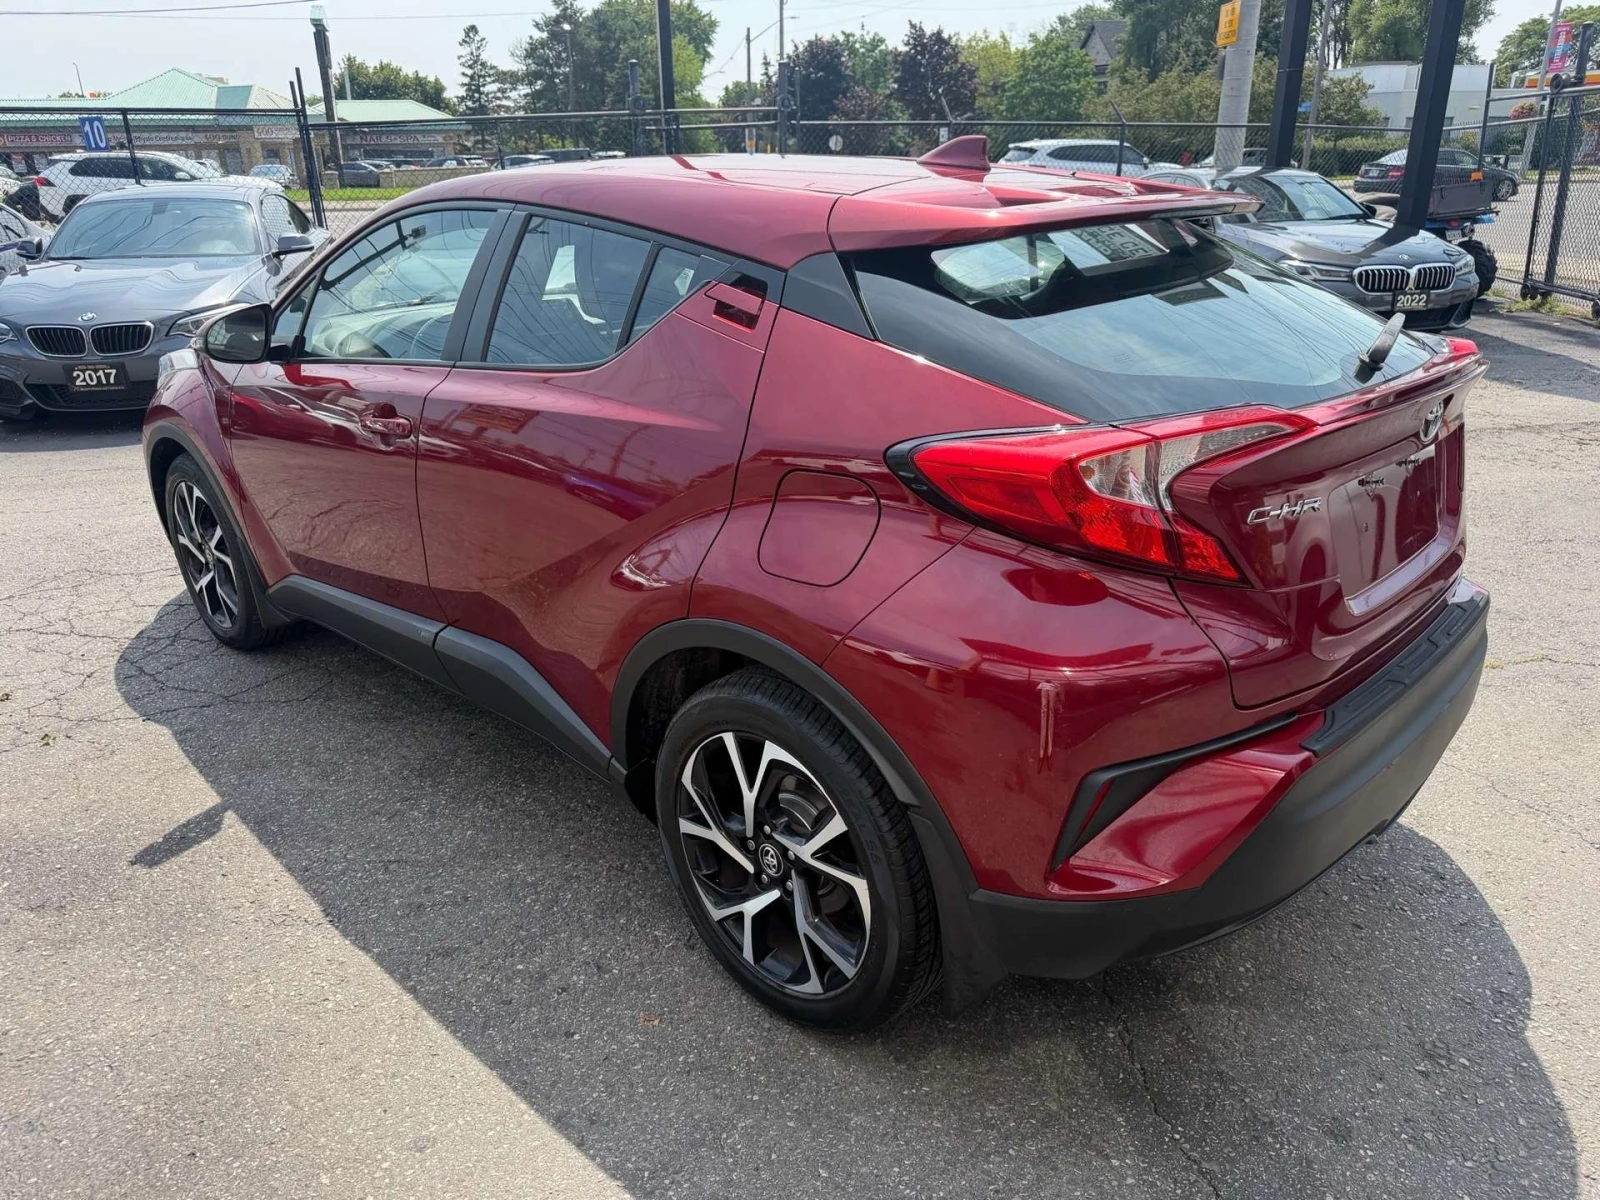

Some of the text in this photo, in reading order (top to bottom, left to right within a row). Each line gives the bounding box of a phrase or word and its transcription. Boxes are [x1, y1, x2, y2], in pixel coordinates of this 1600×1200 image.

[84, 120, 106, 148] 10
[360, 135, 393, 143] NAILS
[399, 135, 420, 143] SPA
[1396, 294, 1427, 306] 2022
[73, 369, 116, 386] 2017
[1247, 497, 1322, 525] C-HR
